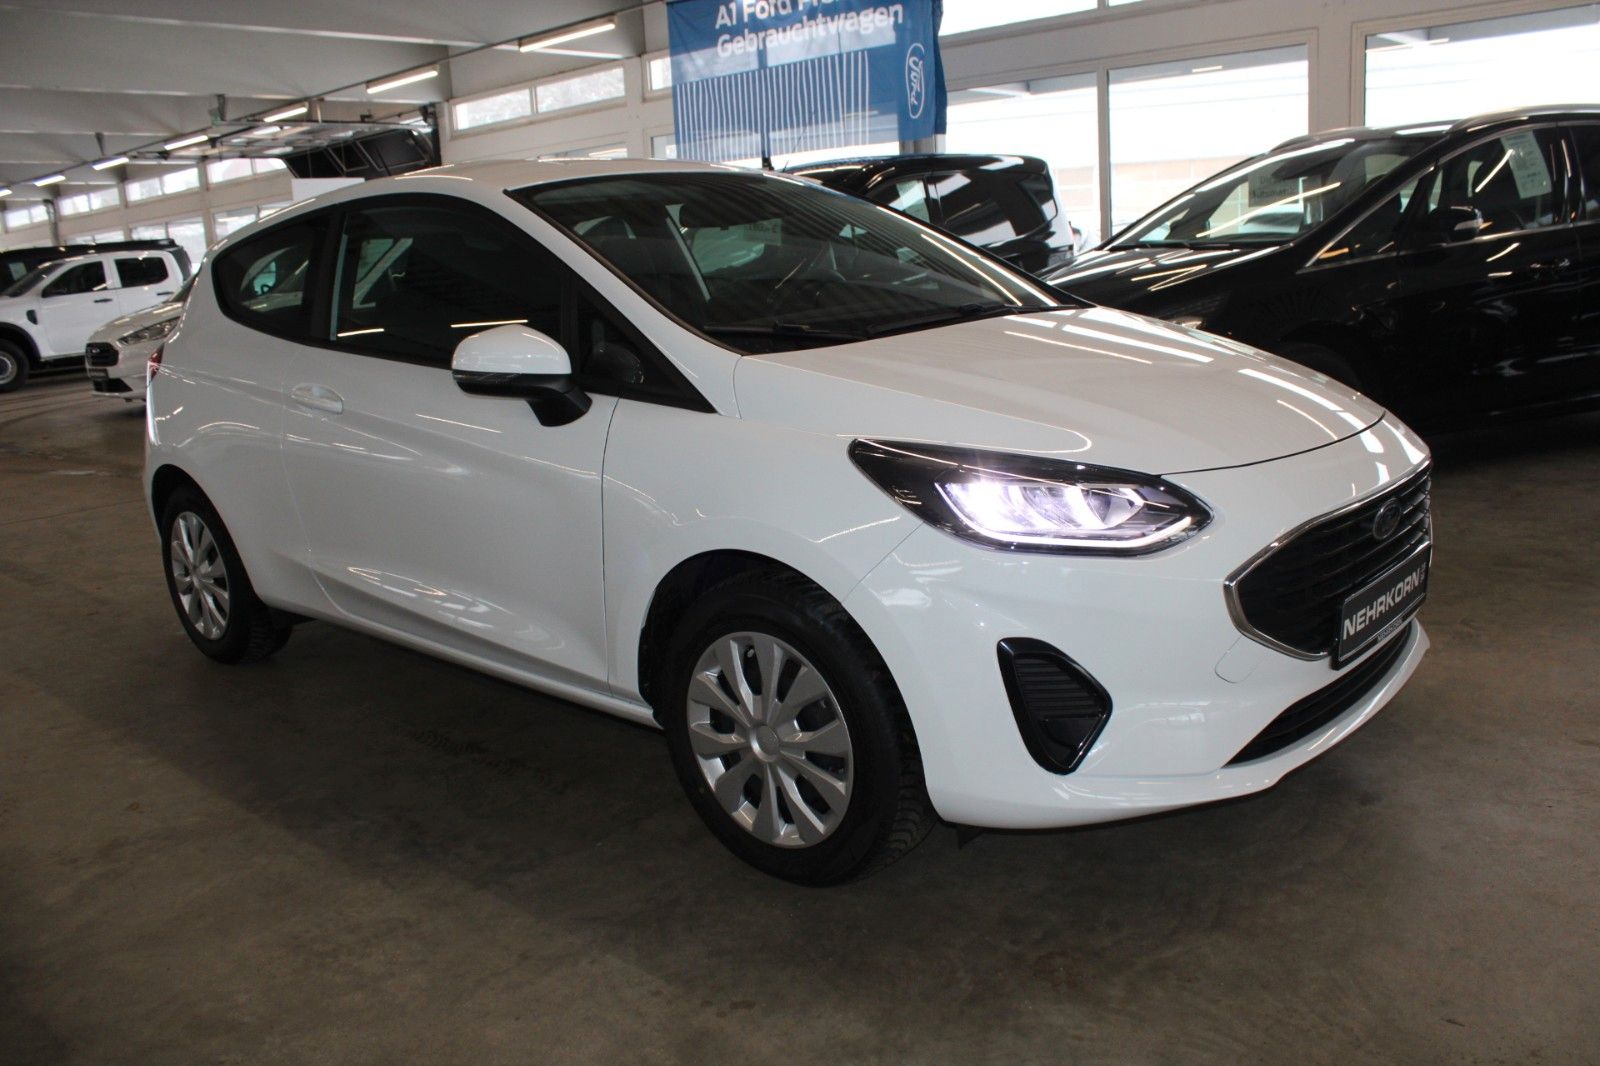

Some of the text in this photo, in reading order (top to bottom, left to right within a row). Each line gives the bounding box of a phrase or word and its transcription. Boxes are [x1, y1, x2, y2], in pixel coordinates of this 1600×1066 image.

[716, 3, 737, 29] A1
[716, 4, 904, 57] Gebrauchtwagen
[1343, 570, 1420, 640] NEHRKORN
